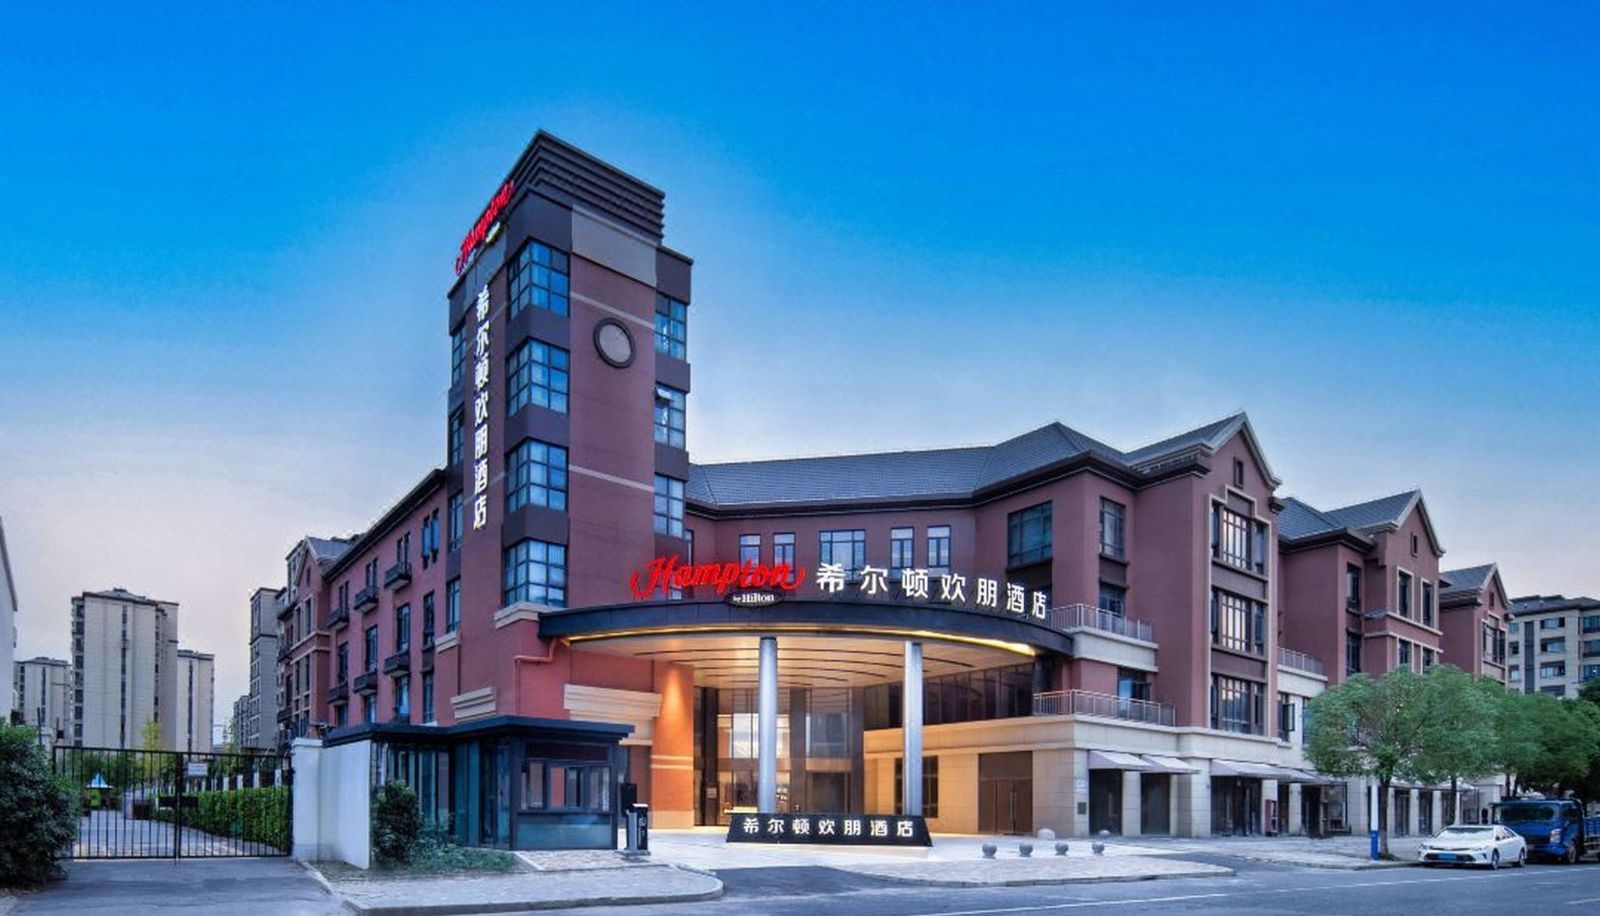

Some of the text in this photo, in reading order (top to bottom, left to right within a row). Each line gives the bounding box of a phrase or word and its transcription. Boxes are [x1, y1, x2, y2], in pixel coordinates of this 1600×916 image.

[473, 284, 491, 530] 希尔顿欢朋酒店
[630, 555, 806, 600] Hampton
[742, 592, 774, 603] Hilton
[816, 562, 1048, 619] 希尔顿欢朋酒店
[743, 817, 914, 837] 希尔顿欢朋酒店
